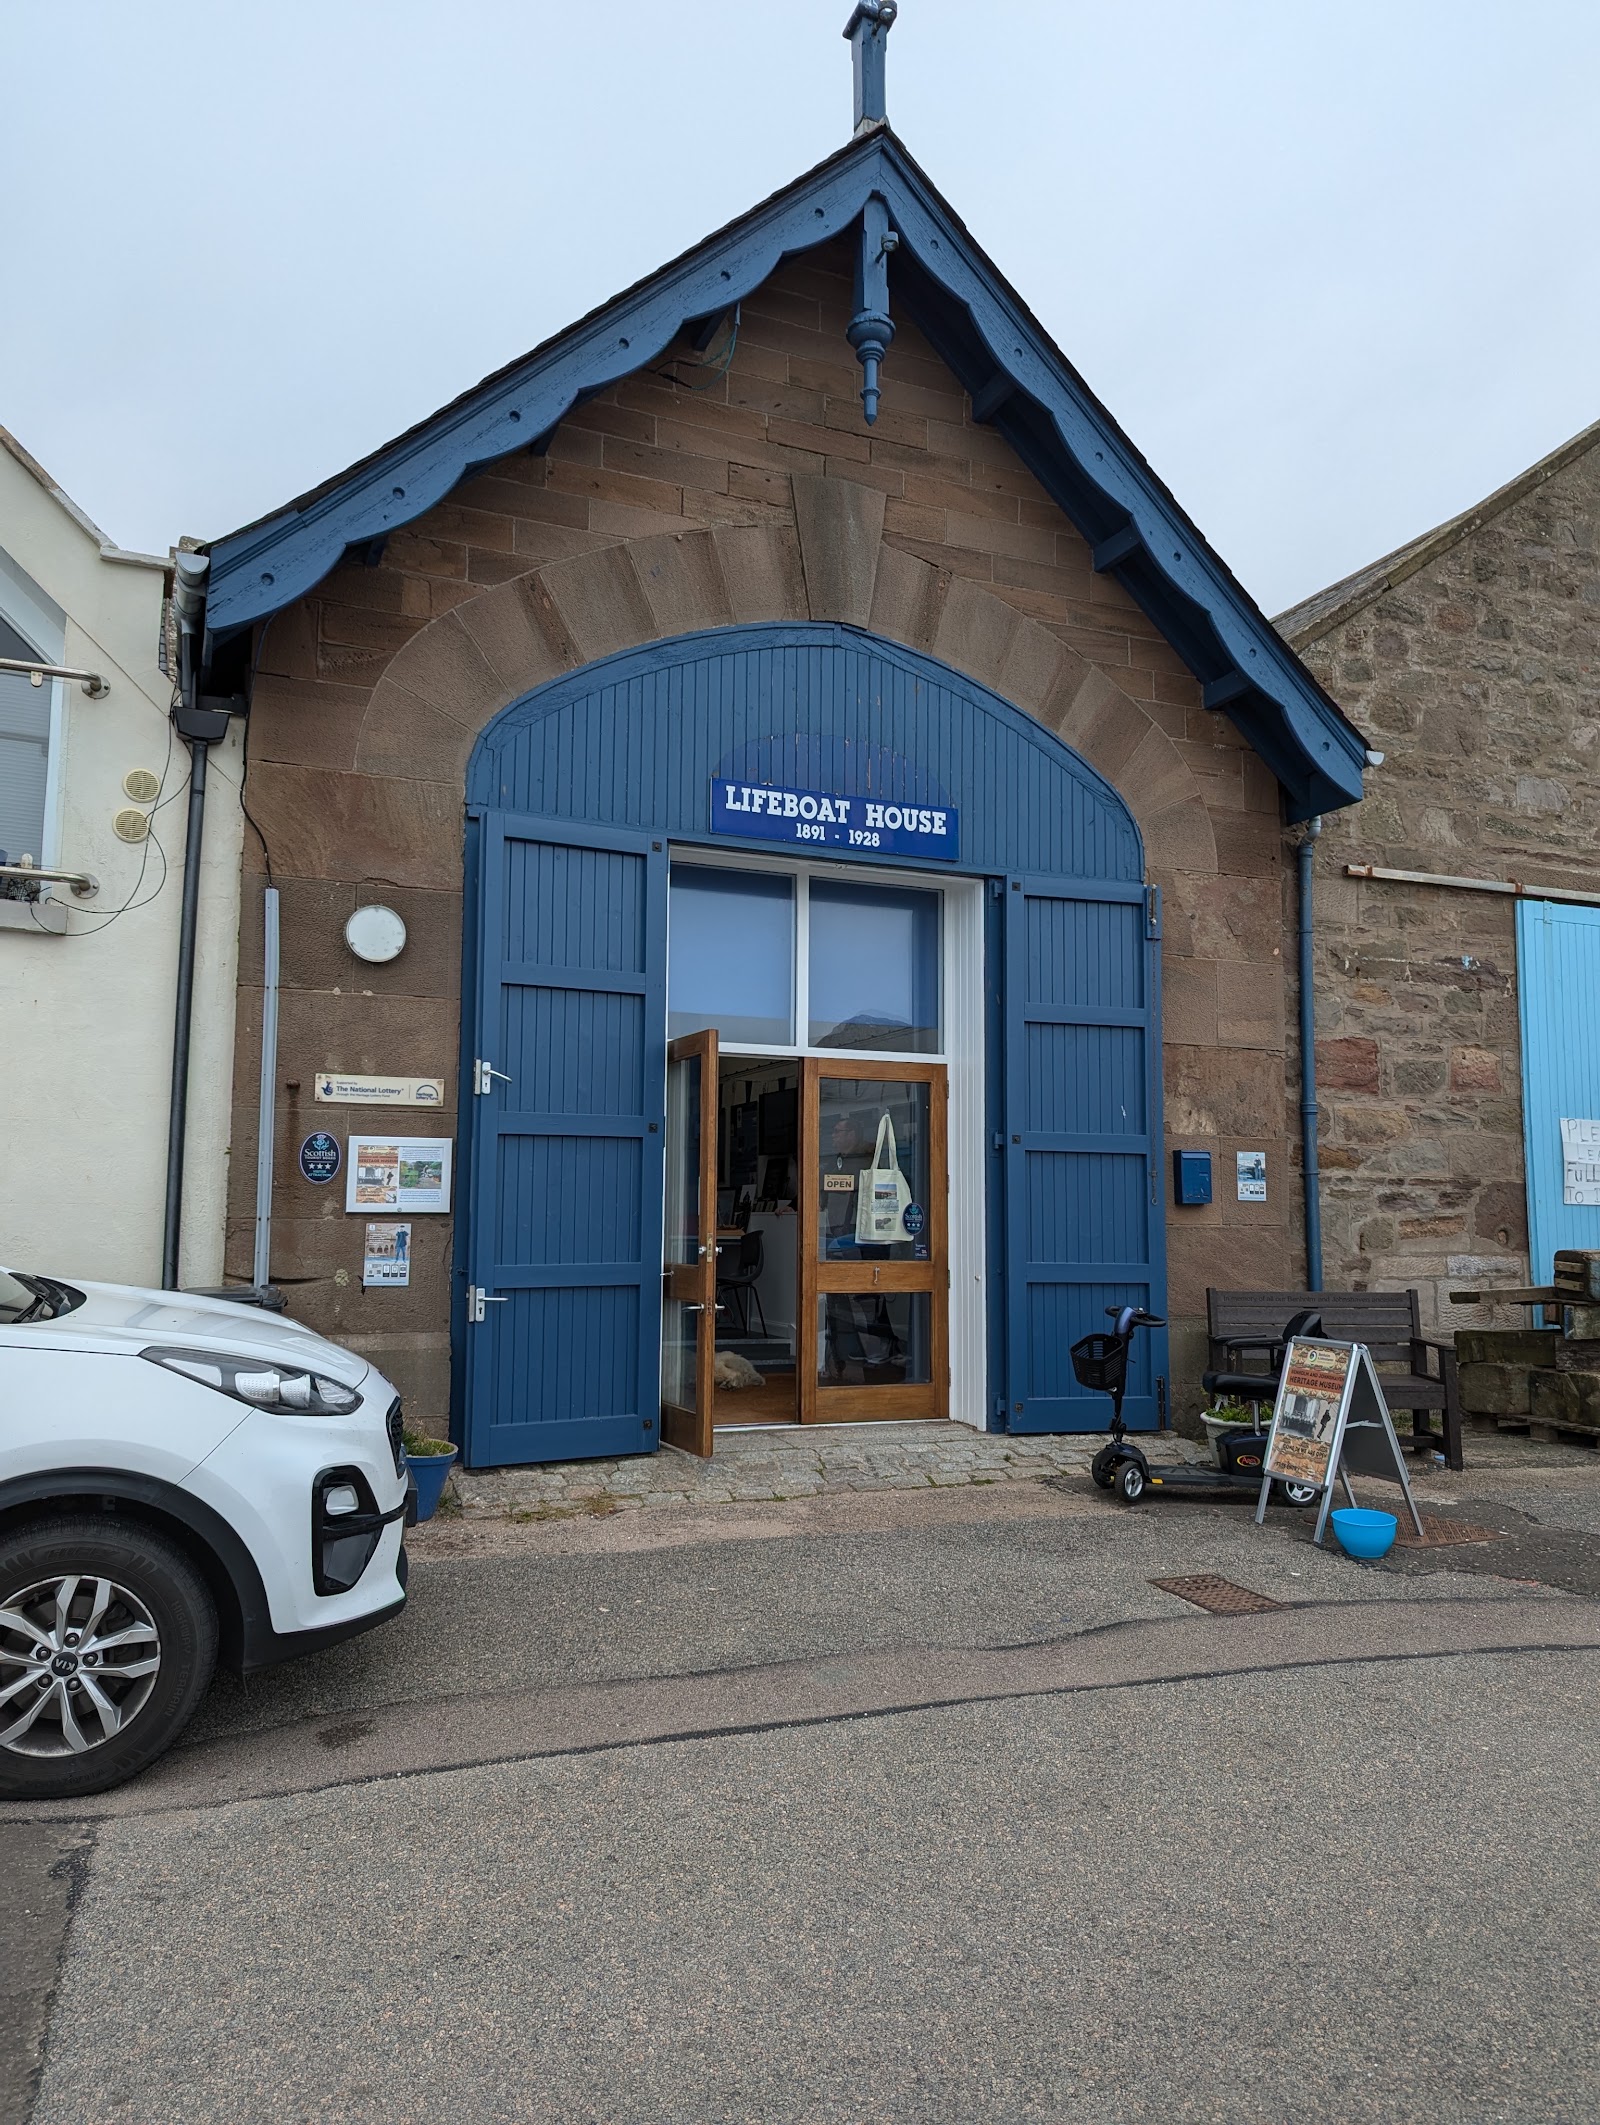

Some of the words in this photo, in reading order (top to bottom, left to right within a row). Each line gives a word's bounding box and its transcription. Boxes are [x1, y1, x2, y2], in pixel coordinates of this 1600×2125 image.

[725, 785, 850, 824] LIFEBOAT
[865, 803, 947, 835] HOUSE
[796, 823, 825, 841] 1891
[849, 829, 880, 847] 1928
[304, 1148, 336, 1157] Scottish
[826, 1180, 852, 1188] OPEN
[1290, 1376, 1318, 1386] HERITAGE
[1319, 1381, 1343, 1390] MUSEUM
[55, 1658, 75, 1671] KIA
